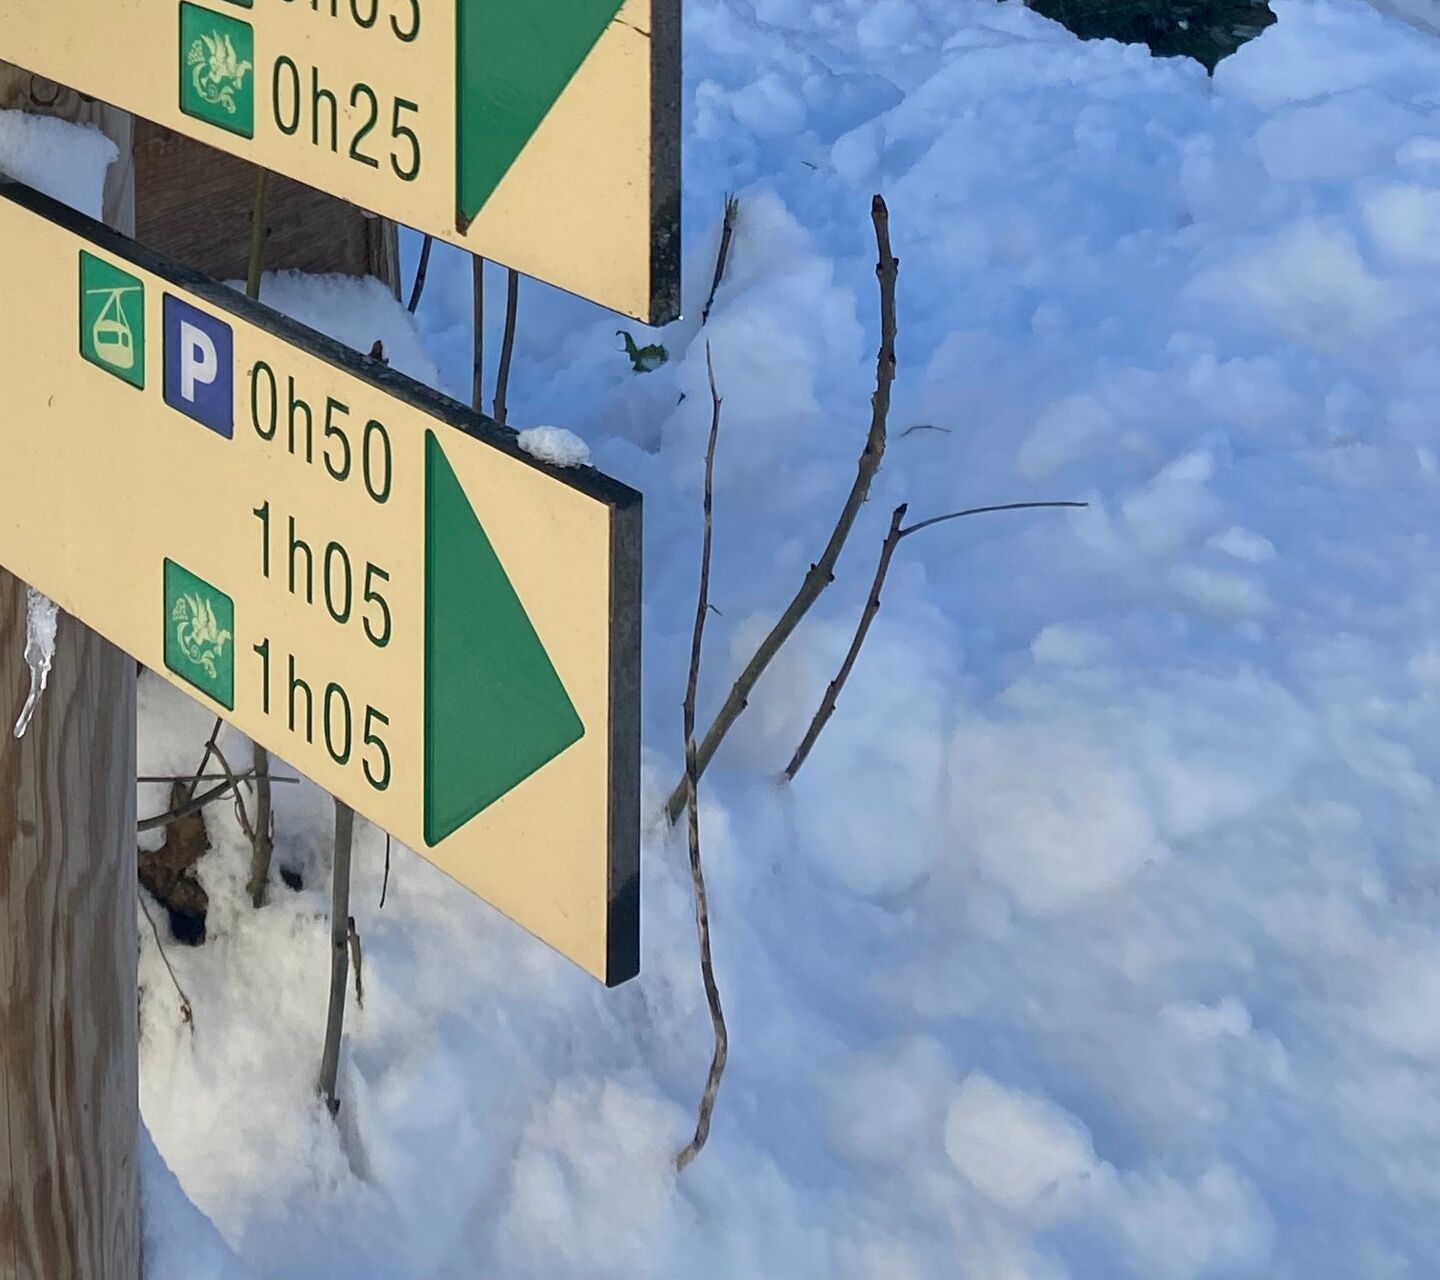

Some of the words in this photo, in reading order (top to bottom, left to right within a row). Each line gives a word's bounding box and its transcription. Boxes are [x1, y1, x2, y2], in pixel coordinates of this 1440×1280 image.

[273, 56, 420, 181] 0h25
[181, 319, 218, 403] P
[251, 361, 392, 504] 0h50
[253, 501, 391, 647] 1h05
[253, 638, 390, 791] 1h05
